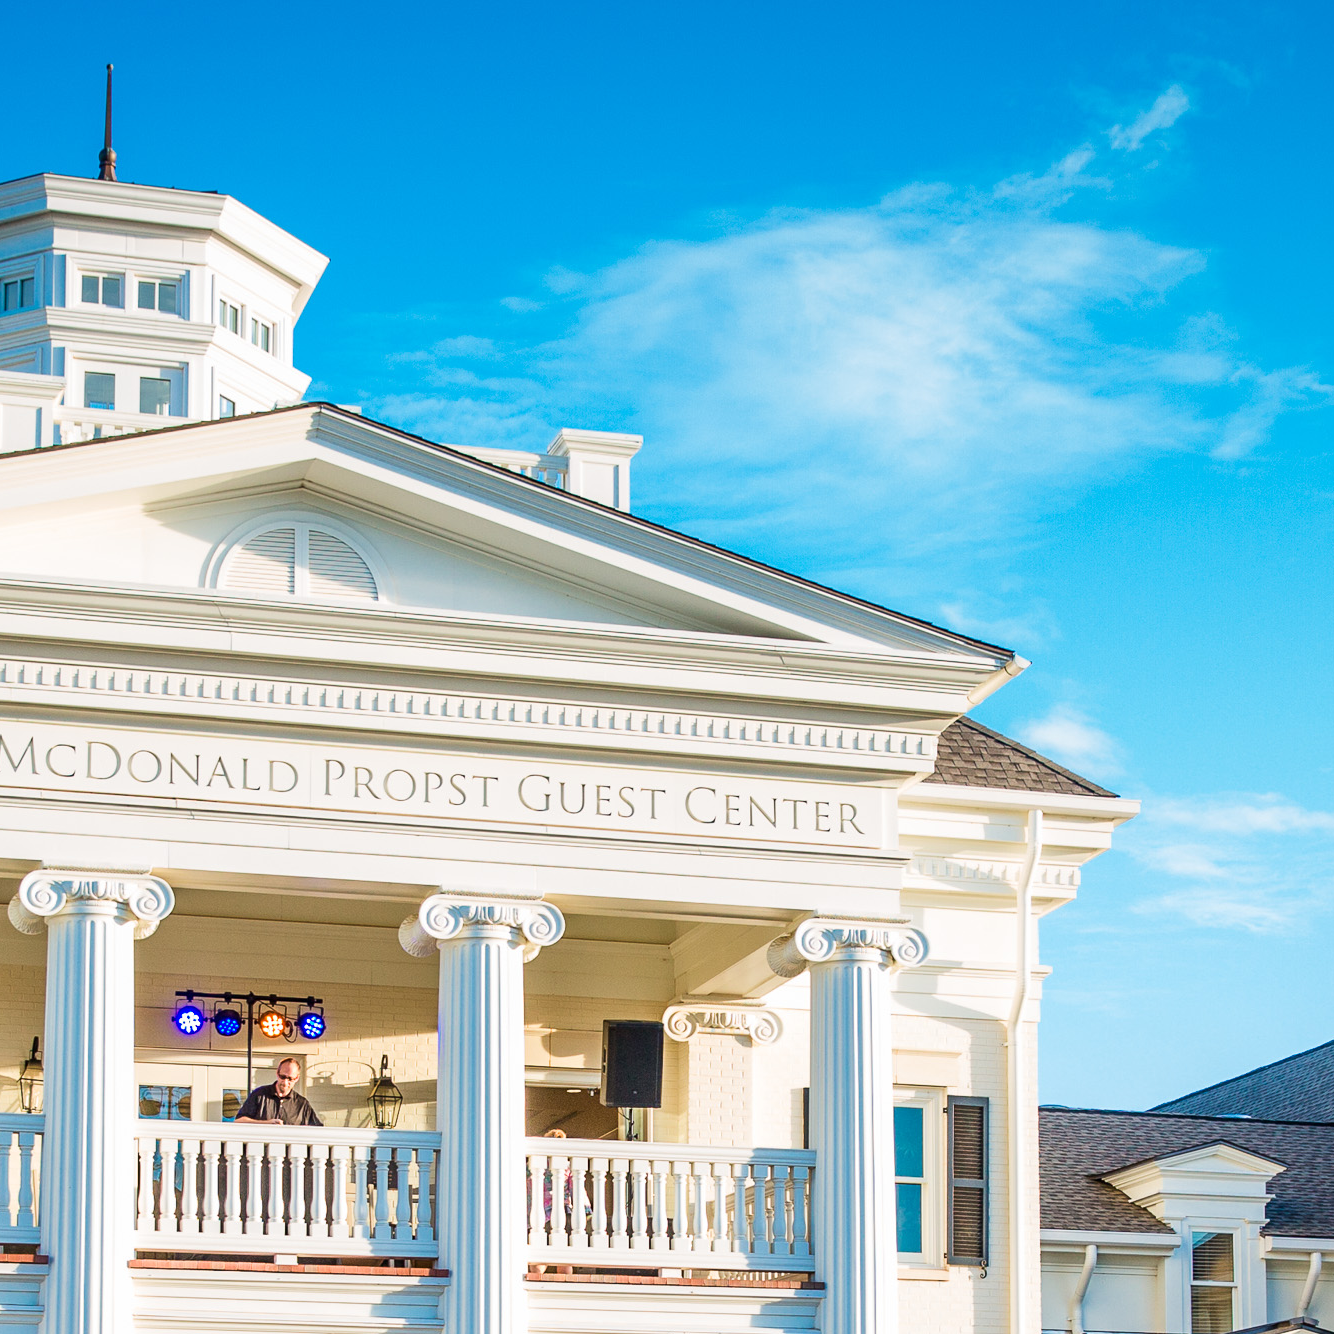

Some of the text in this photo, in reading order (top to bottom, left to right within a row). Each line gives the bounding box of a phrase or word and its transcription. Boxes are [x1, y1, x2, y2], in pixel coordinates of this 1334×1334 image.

[323, 758, 499, 808] PROPST
[517, 774, 667, 820] GUEST
[684, 786, 866, 836] CENTER
